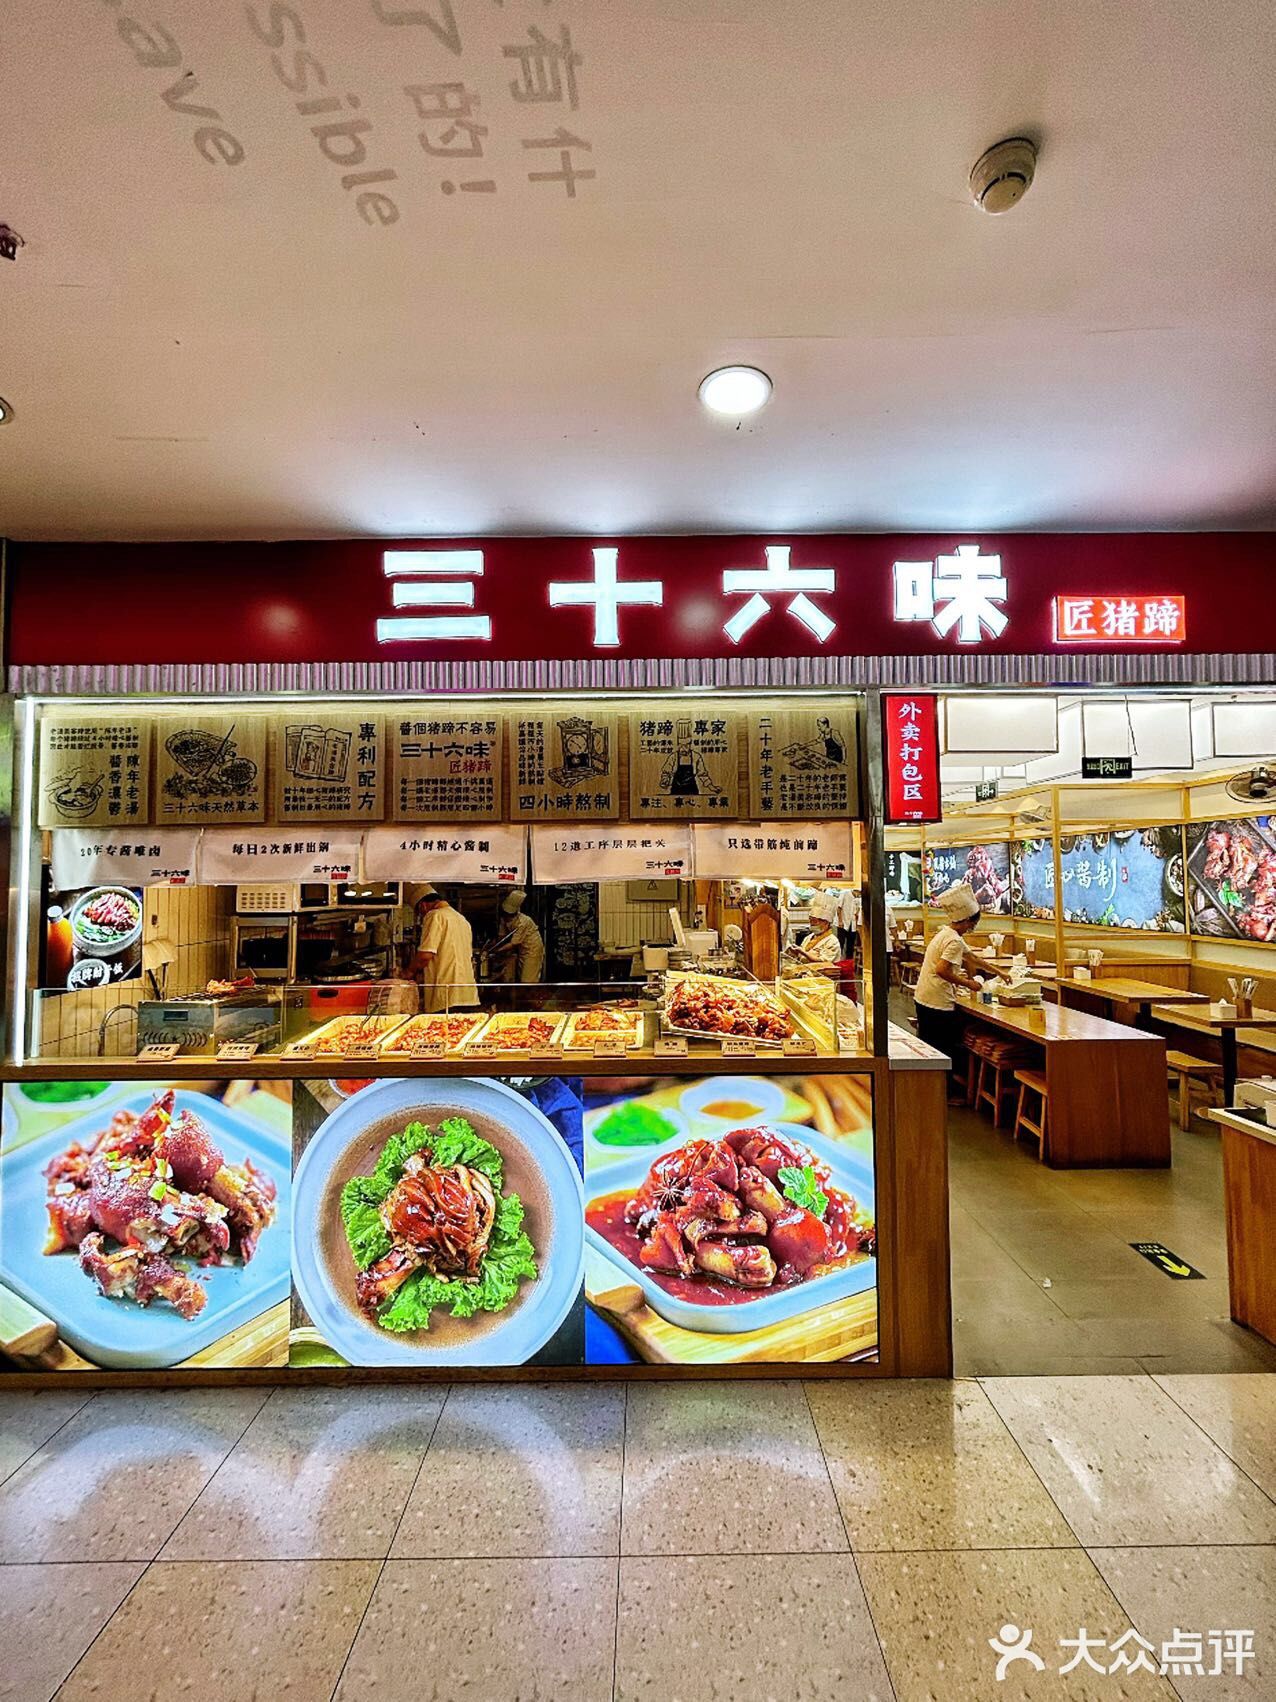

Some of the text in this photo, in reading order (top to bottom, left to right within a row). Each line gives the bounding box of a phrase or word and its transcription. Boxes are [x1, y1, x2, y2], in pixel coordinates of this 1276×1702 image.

[376, 545, 1009, 645] 三十六味
[1063, 598, 1180, 636] 匠猪蹄
[640, 719, 726, 736] 猪蹄 專家
[400, 741, 490, 758] 三十六味
[898, 701, 923, 800] 外卖打包区
[358, 723, 376, 810] 專利配方
[450, 759, 492, 774] 匠猪蹄
[163, 801, 259, 814] 三十六味天然草本
